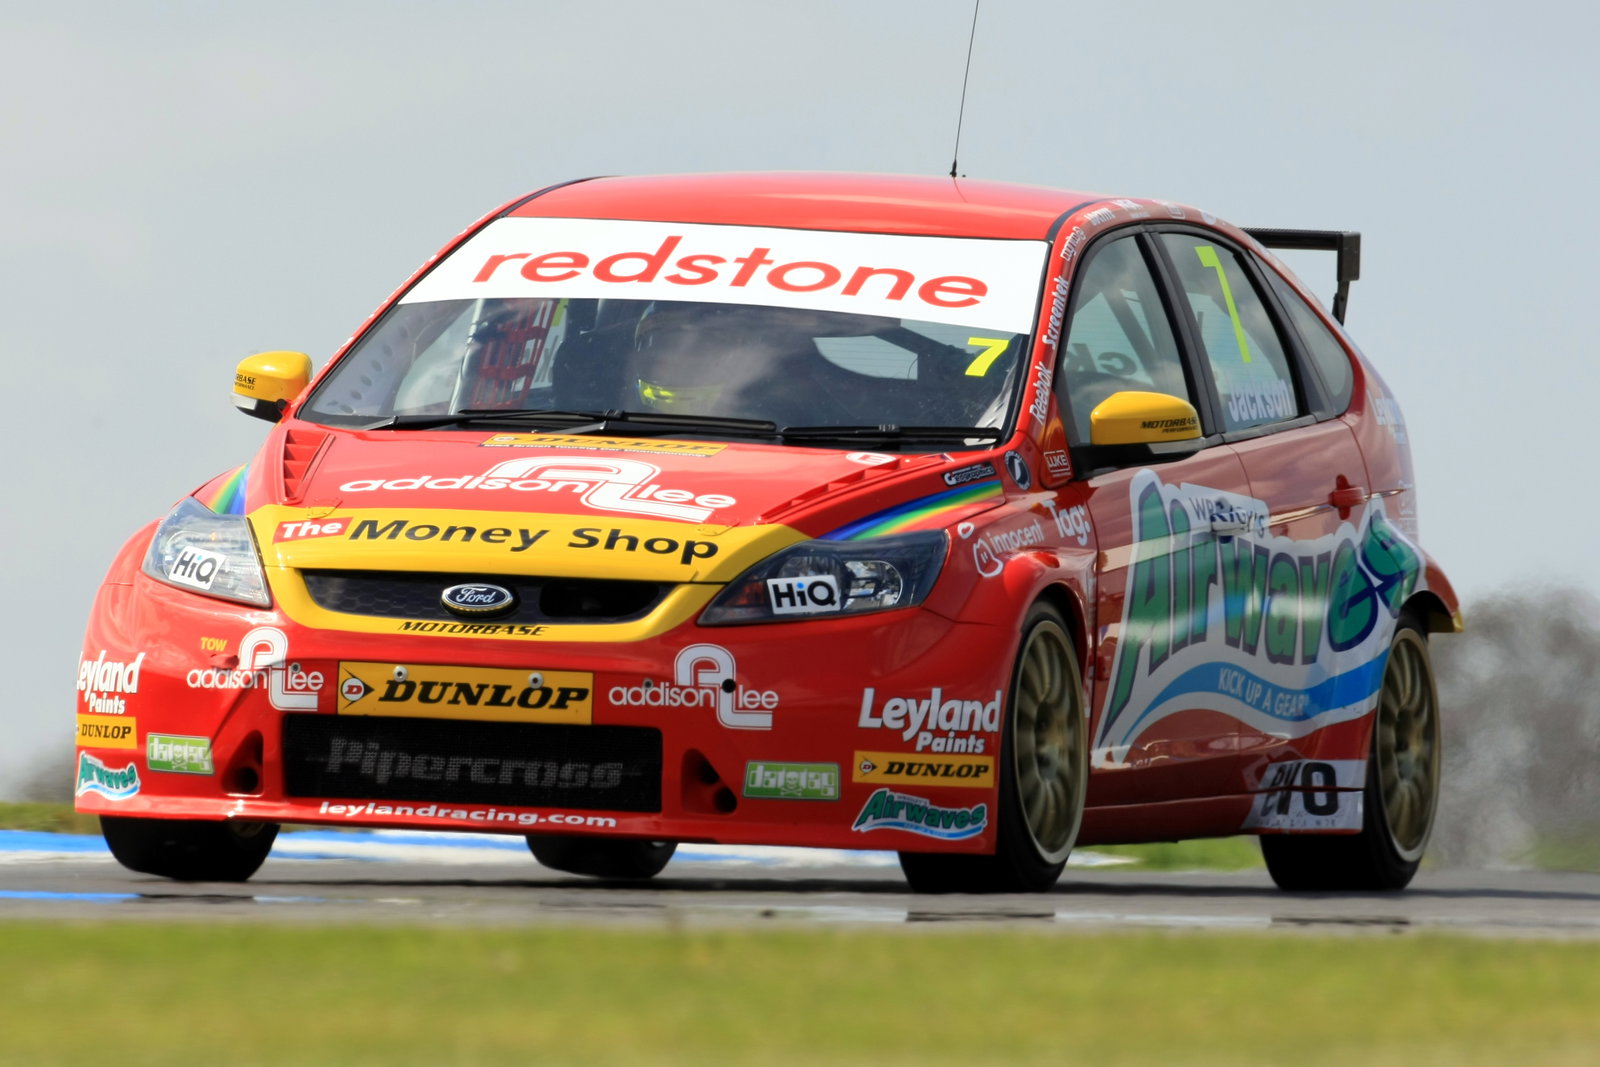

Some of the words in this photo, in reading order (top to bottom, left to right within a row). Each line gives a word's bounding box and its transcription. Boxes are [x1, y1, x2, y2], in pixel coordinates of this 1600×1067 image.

[472, 235, 989, 308] redstone
[1042, 275, 1069, 350] Screentek
[1194, 246, 1252, 364] 7
[964, 337, 1010, 377] 7
[1030, 361, 1054, 425] Reebok
[1228, 378, 1293, 422] Jackson
[532, 437, 721, 450] DUNLOP
[339, 475, 590, 493] addison
[636, 484, 737, 509] lee
[282, 522, 343, 539] The
[349, 520, 550, 553] Money
[567, 527, 719, 565] Shop
[986, 519, 1045, 554] innocent
[172, 550, 217, 585] HiQ
[455, 586, 496, 605] Ford
[772, 581, 837, 608] HiQ
[200, 637, 228, 652] TOW
[398, 621, 549, 637] MOTORBASE
[186, 666, 268, 690] addison
[287, 665, 324, 690] lee
[378, 679, 590, 710] DUNLOP
[1218, 667, 1246, 697] KICK
[1246, 680, 1263, 706] UP
[1262, 687, 1273, 712] A
[89, 692, 127, 715] Paints
[608, 682, 715, 708] addison
[738, 684, 780, 709] lee
[81, 724, 132, 739] DUNLOP
[857, 687, 1002, 742] Leyland
[915, 730, 985, 754] Paints
[324, 735, 624, 789] Pipercross
[883, 761, 989, 779] DUNLOP
[318, 801, 617, 828] leylandracing.com
[854, 789, 986, 830] Airwaves
